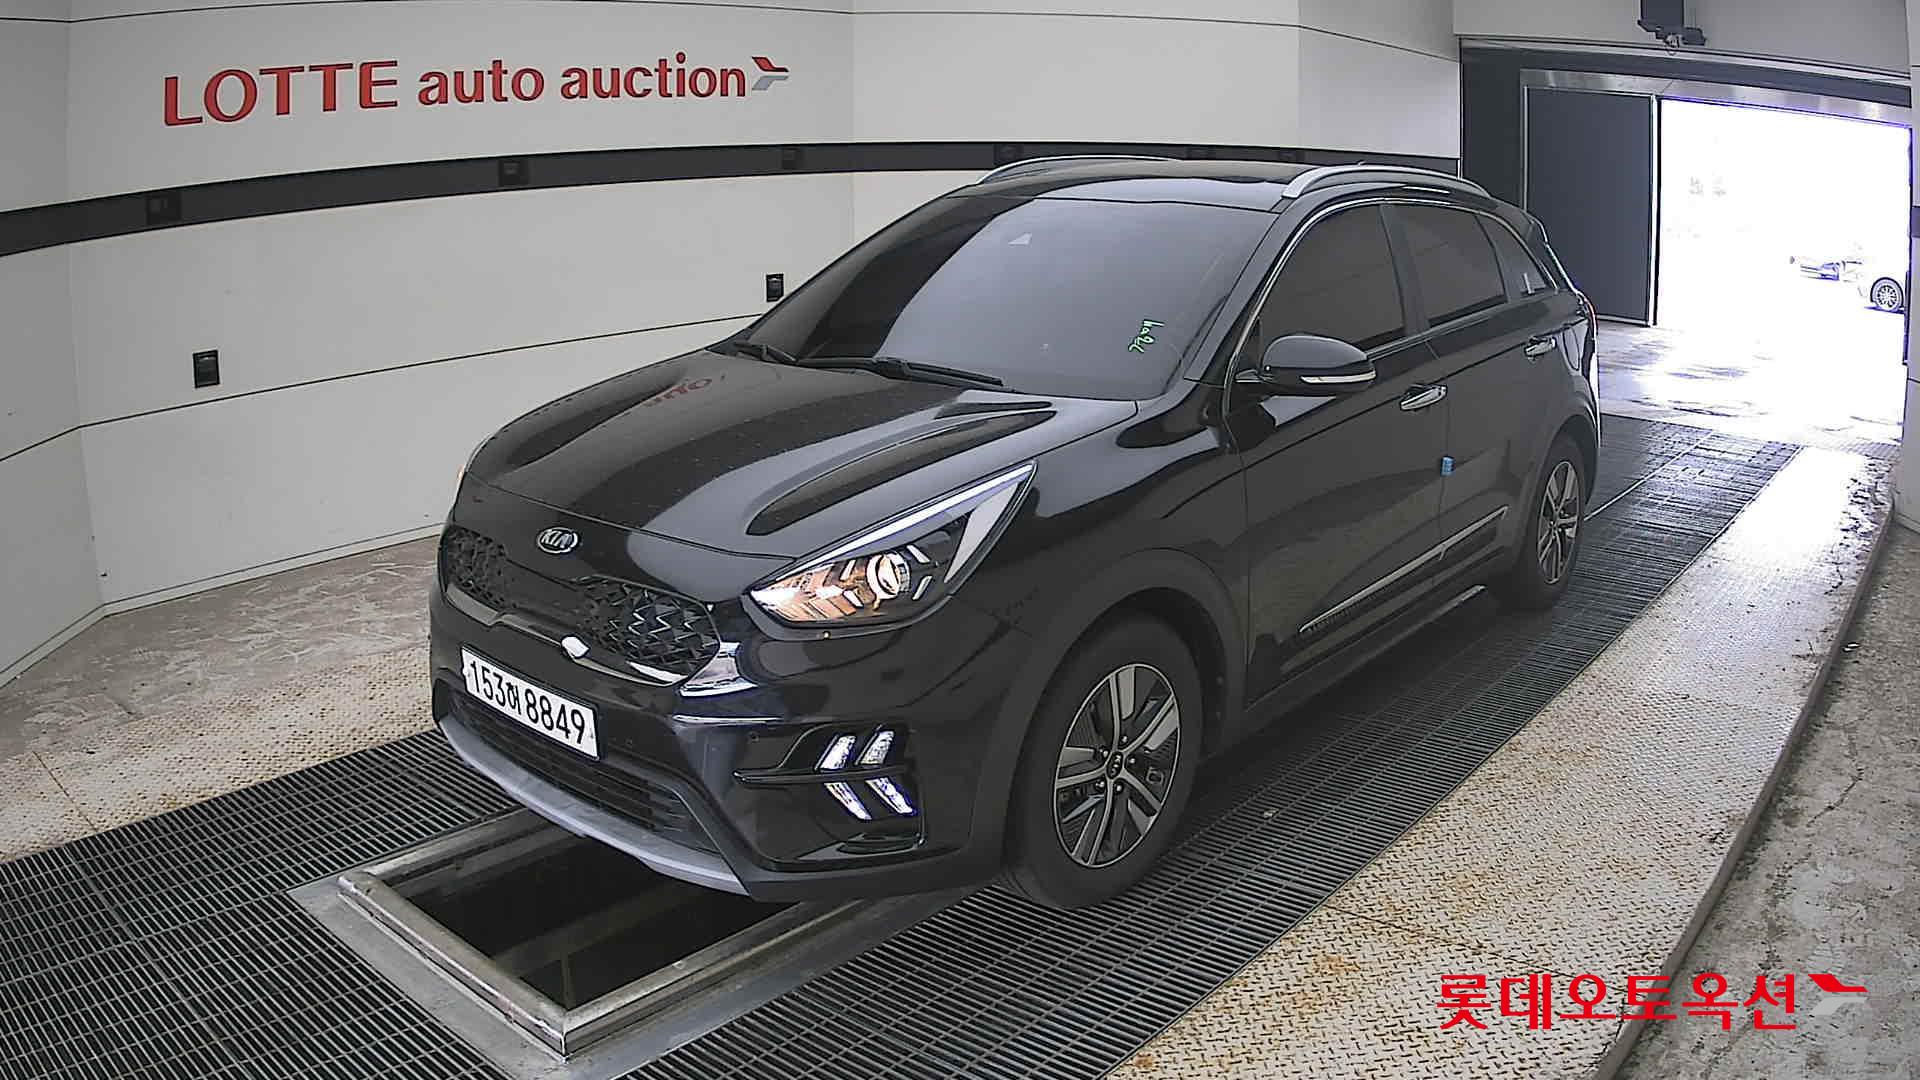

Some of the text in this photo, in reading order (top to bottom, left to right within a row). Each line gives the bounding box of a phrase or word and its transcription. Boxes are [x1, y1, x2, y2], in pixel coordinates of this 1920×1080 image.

[163, 50, 748, 127] LOTTE auto auction
[539, 529, 575, 551] KIA
